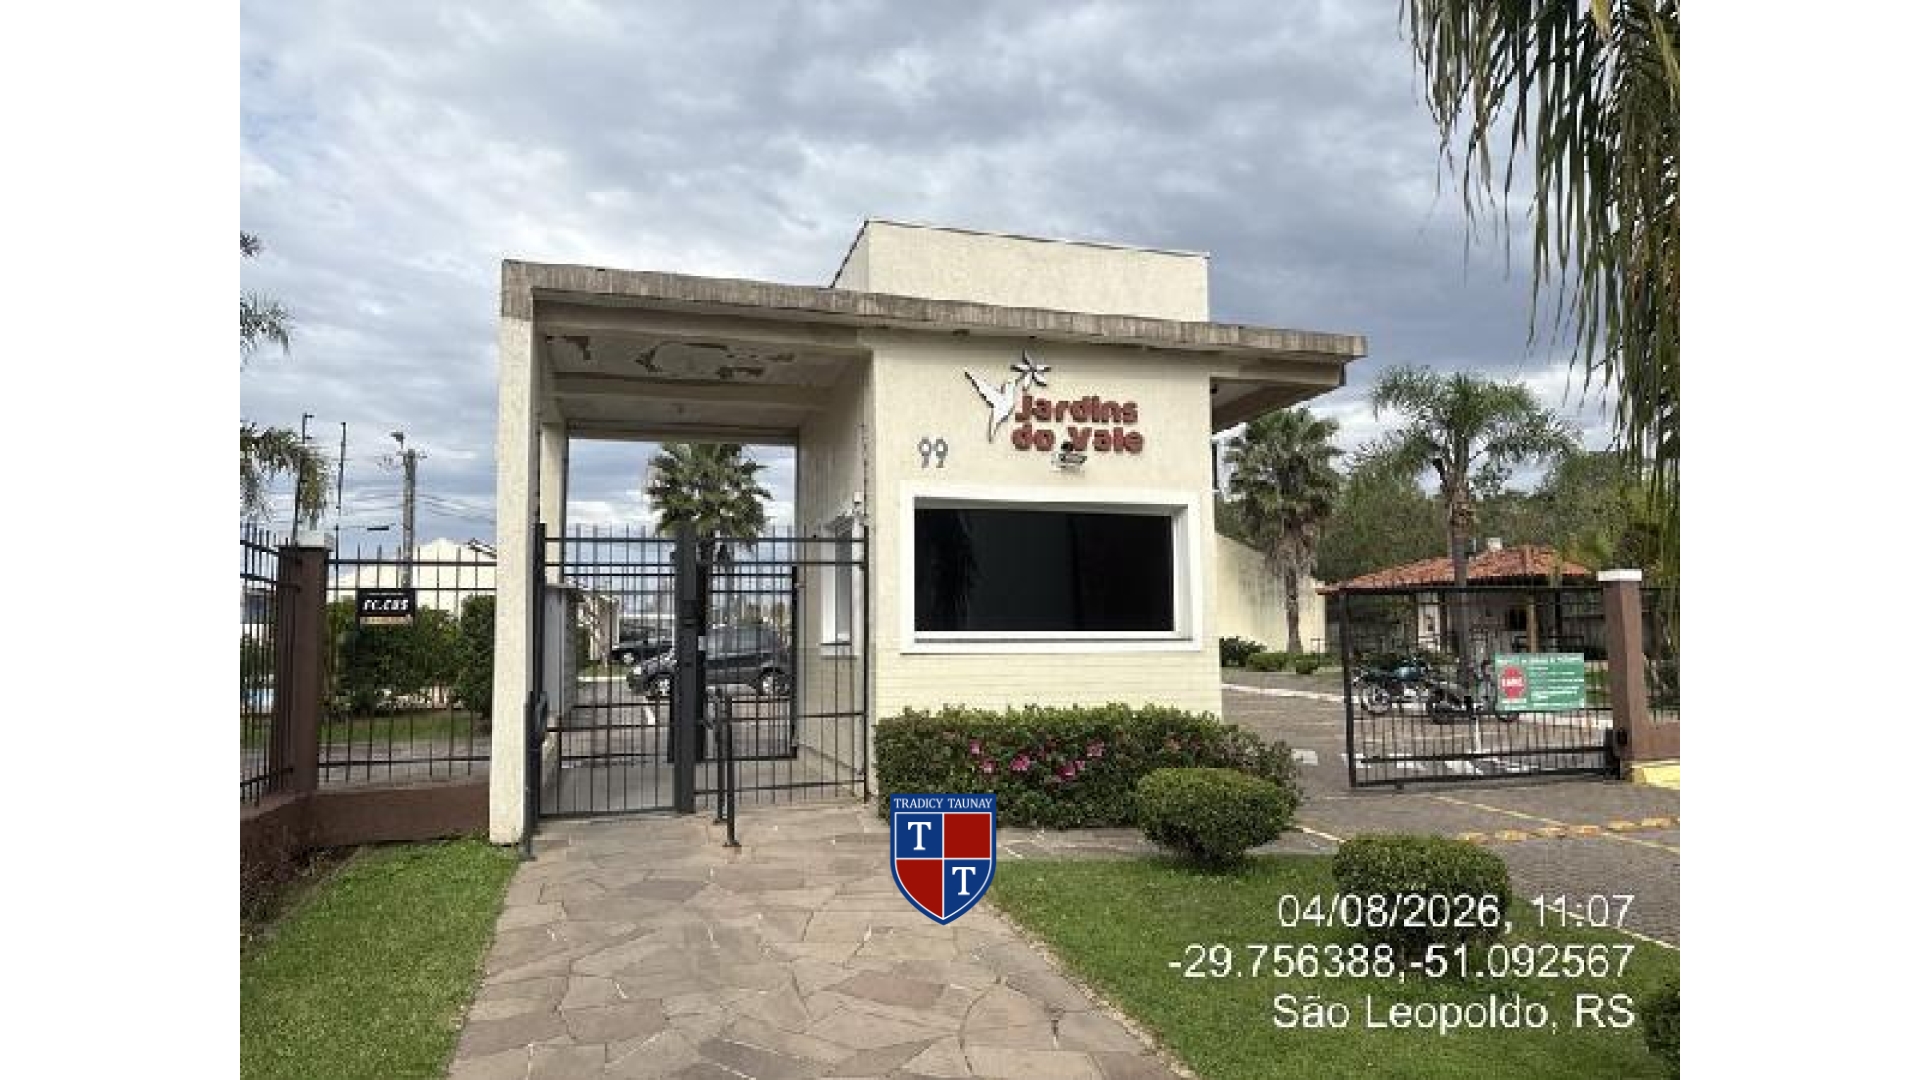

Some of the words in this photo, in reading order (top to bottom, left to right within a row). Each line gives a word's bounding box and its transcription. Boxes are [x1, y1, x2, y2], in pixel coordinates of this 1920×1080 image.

[1014, 395, 1138, 423] Jardins
[918, 437, 948, 468] 99
[1011, 424, 1056, 451] do
[1068, 427, 1143, 454] Vale
